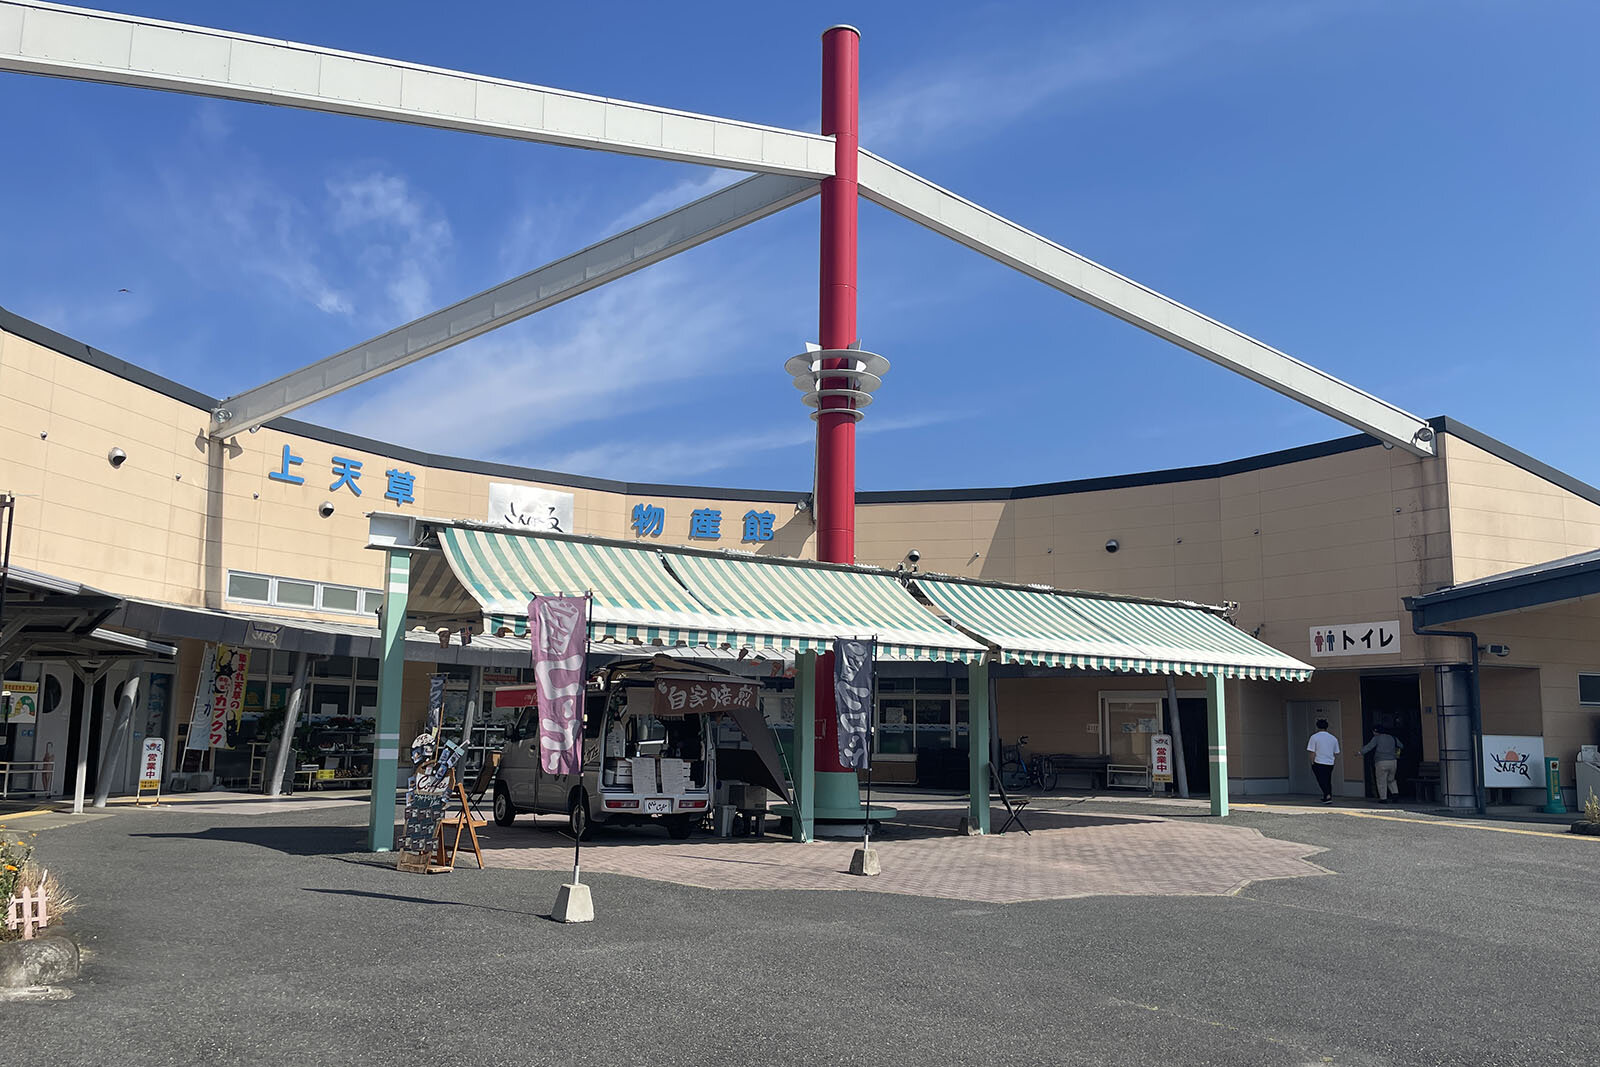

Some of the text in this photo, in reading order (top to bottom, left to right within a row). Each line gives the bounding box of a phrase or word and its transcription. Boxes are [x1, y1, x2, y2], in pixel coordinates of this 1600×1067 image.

[268, 444, 416, 506] 上天草
[632, 503, 777, 545] 物産館
[1342, 628, 1393, 650] トイレ
[668, 683, 753, 710] 自家焙煎
[145, 753, 158, 779] 営業中
[1156, 747, 1167, 772] 営業中
[418, 774, 447, 793] Coffee
